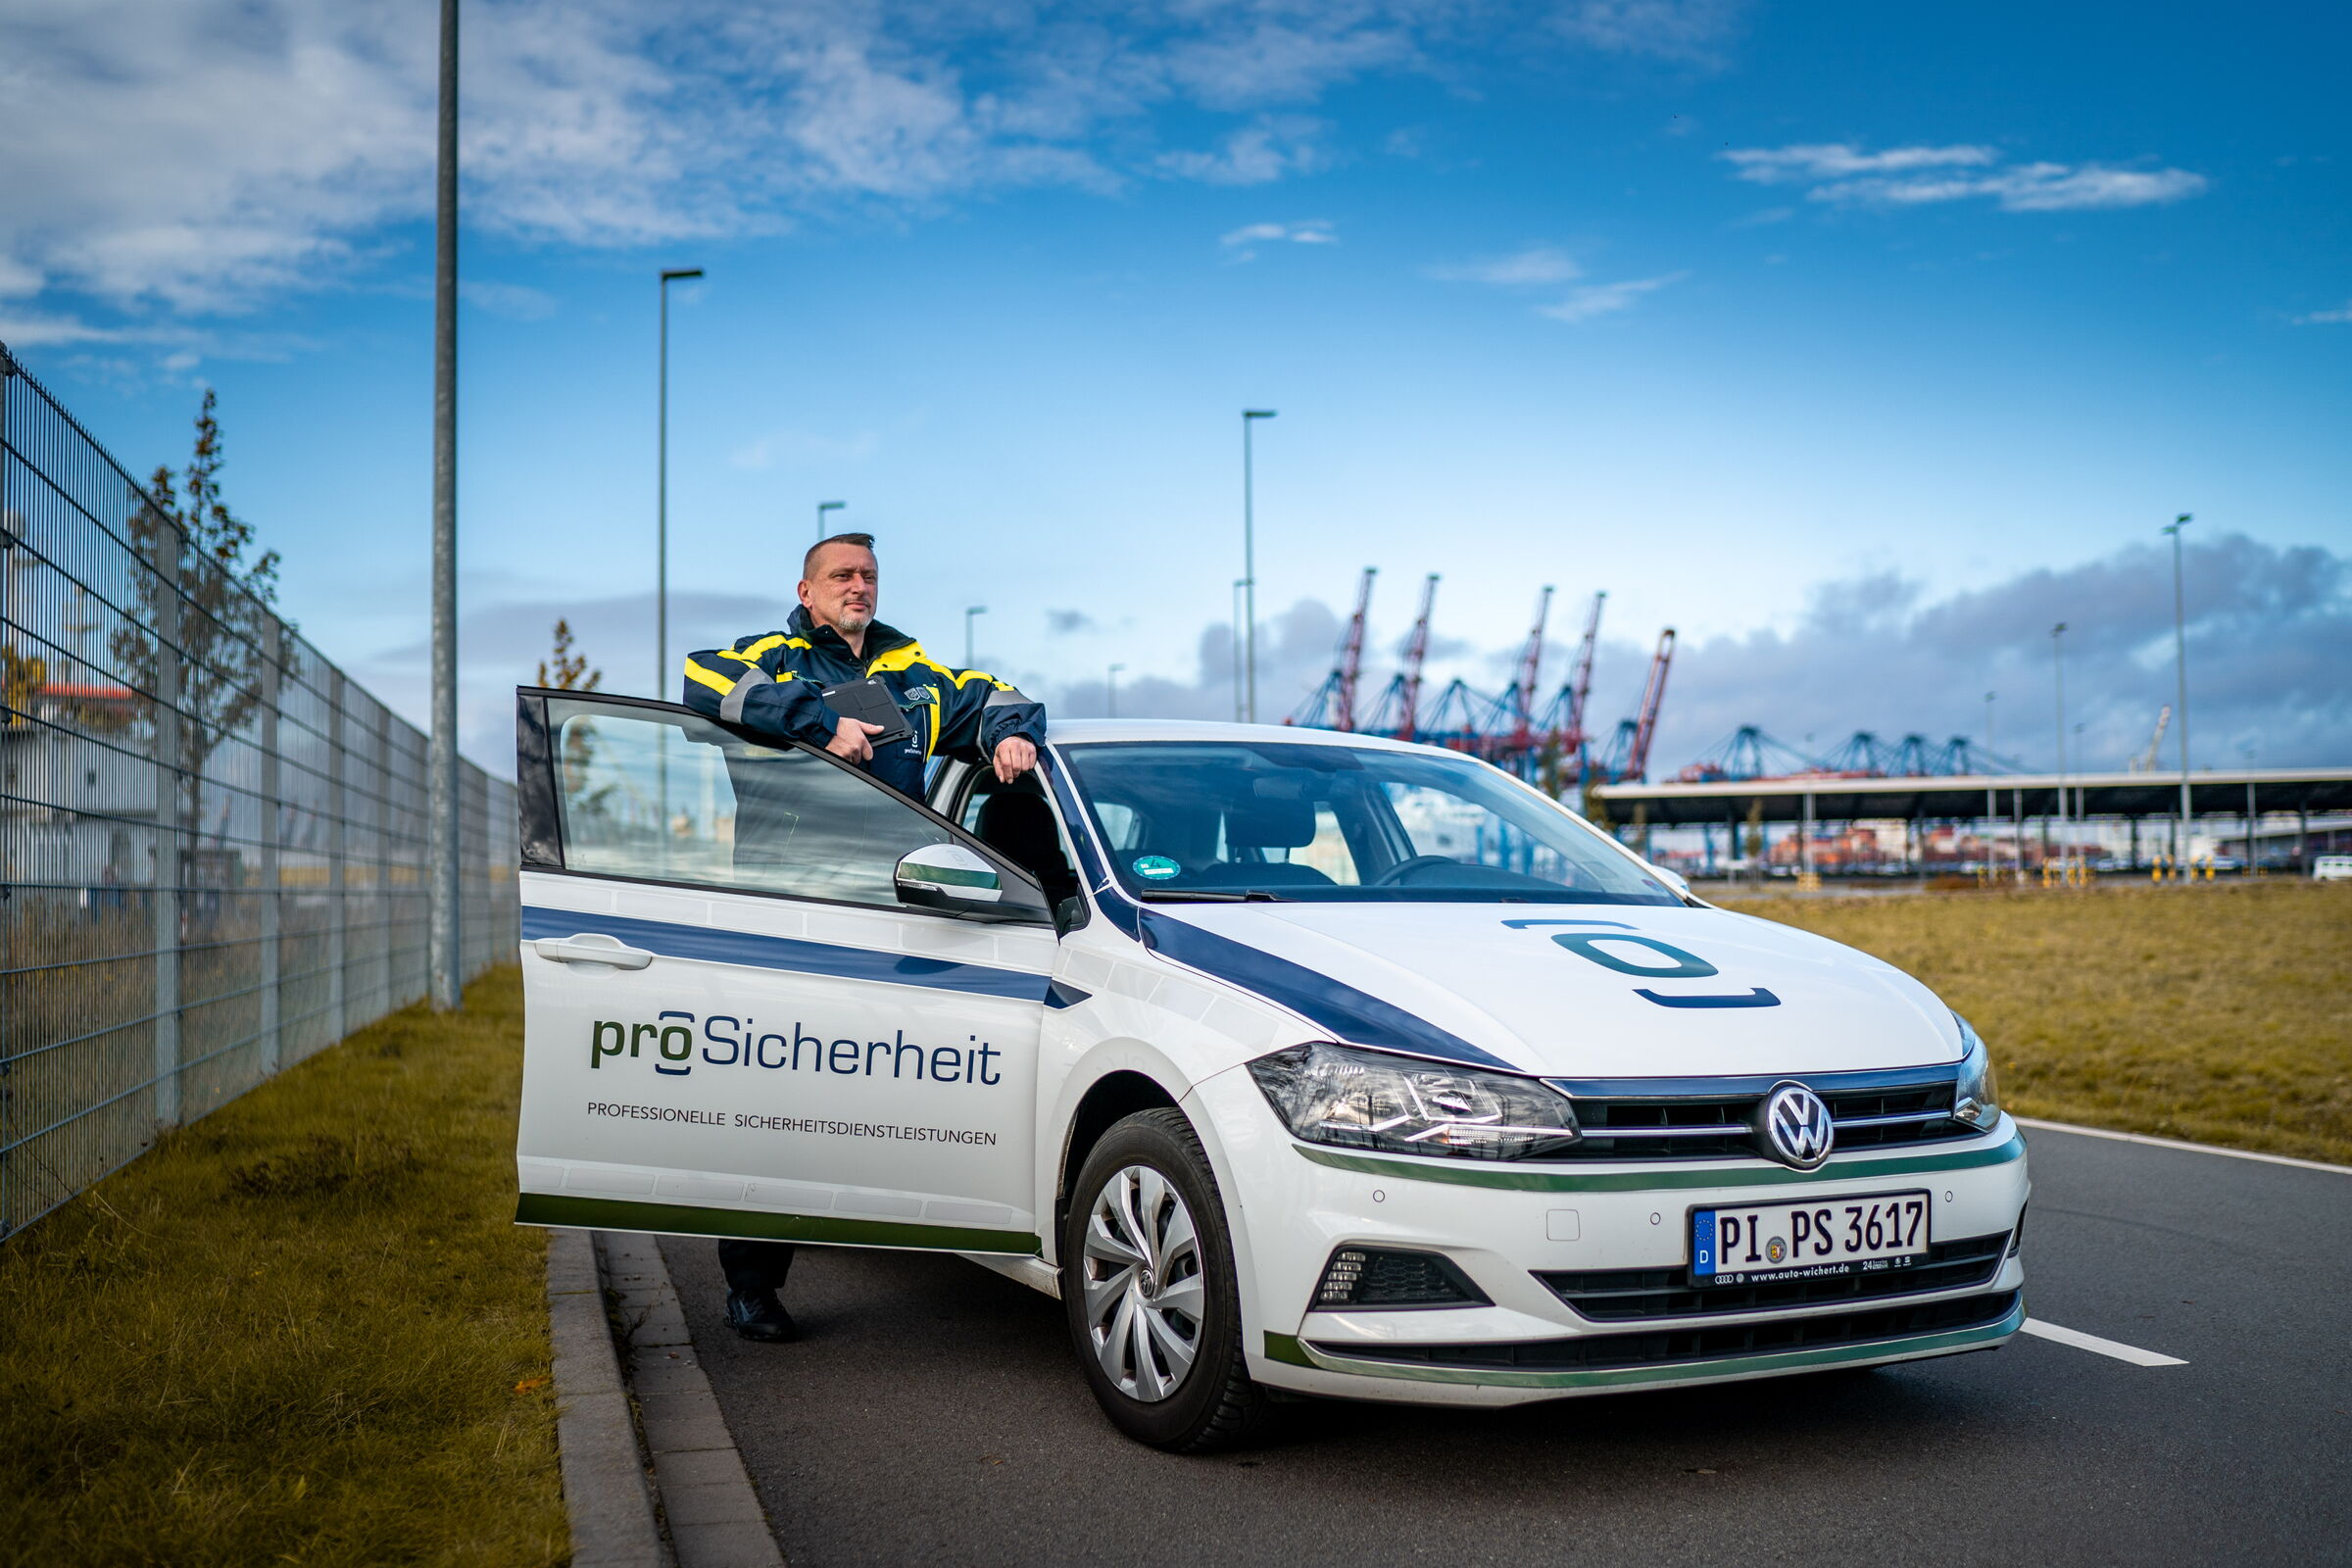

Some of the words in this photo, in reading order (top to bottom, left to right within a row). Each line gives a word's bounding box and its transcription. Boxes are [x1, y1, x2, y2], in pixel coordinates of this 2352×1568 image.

[587, 1102, 726, 1126] PROFESSIONELLE
[734, 1114, 997, 1146] SICHERHEITSDIENSTLEISTUNGEN
[1720, 1215, 1761, 1264] PI
[1790, 1208, 1833, 1257] PS
[1844, 1201, 1923, 1252] 3617
[1699, 1250, 1709, 1264] D
[1751, 1264, 1849, 1282] www.auto-wichert.de
